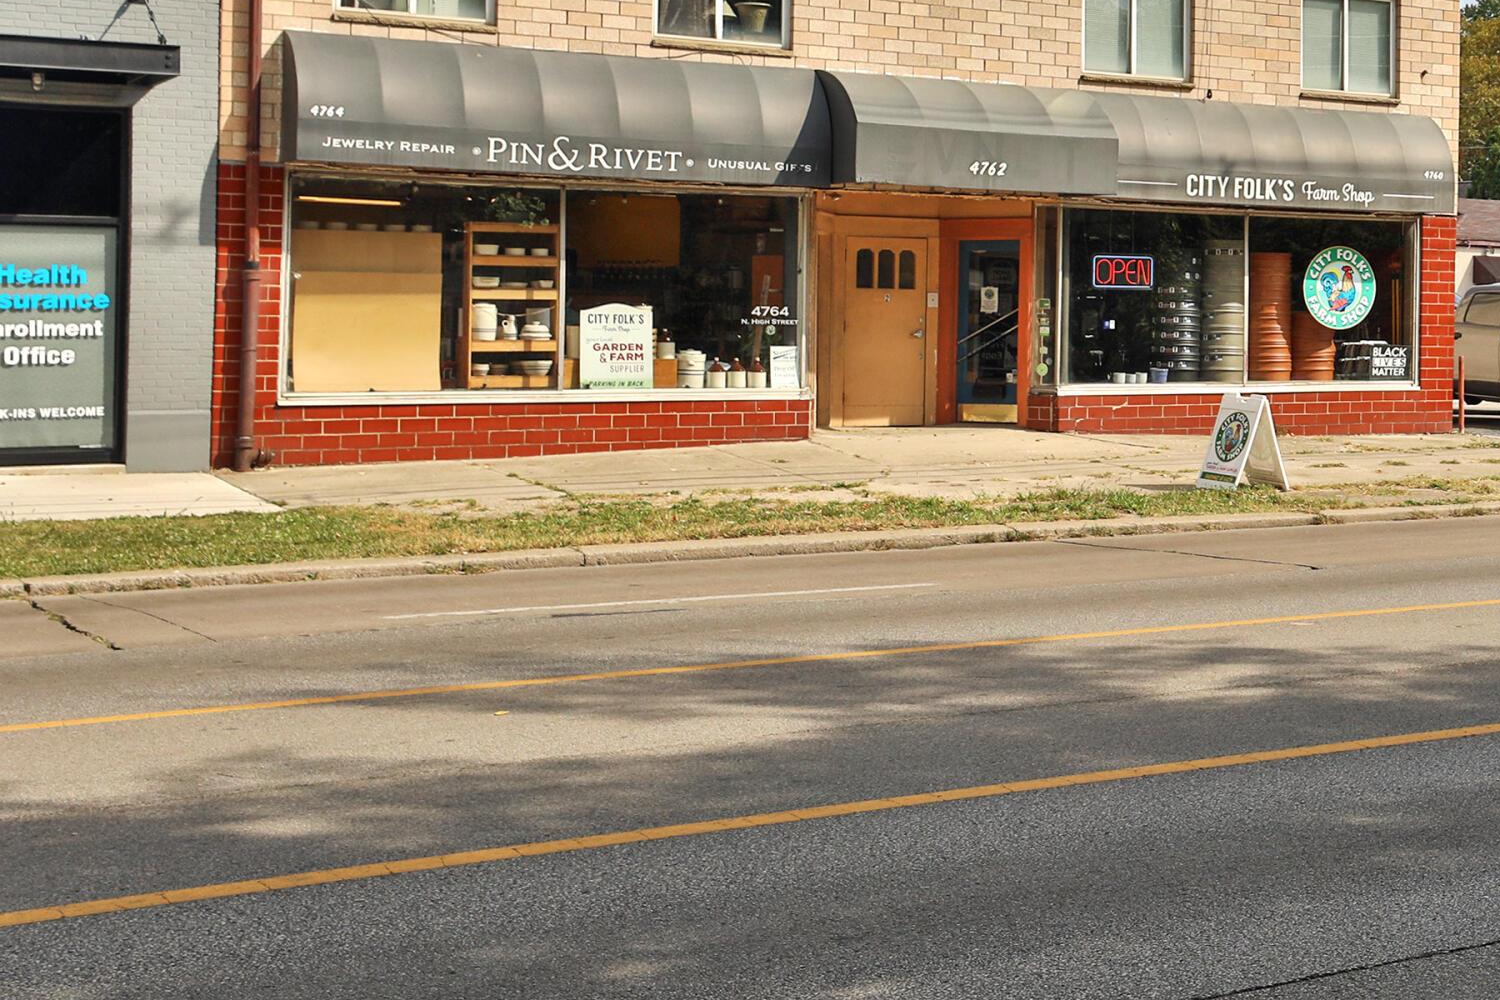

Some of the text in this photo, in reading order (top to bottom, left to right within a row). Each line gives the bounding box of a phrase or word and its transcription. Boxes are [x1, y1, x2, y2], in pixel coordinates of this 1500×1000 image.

[310, 104, 345, 117] 4764
[322, 136, 456, 154] JEWELRY REPAIR
[707, 158, 812, 172] UNUSUAL GIFS
[969, 160, 1008, 176] 4762
[1424, 170, 1444, 180] 4760
[1186, 173, 1376, 208] CITY FOLK'S Farm Shop
[1309, 248, 1372, 281] CITY FOLK'S
[0, 263, 88, 284] Health
[1095, 258, 1151, 285] OPEN
[751, 305, 789, 317] 4764
[1308, 295, 1370, 325] FARM SHOP
[587, 313, 645, 325] CITY FOLK'S
[592, 342, 644, 352] GARDEN
[1372, 346, 1408, 358] BLACK
[3, 346, 76, 366] Office
[599, 352, 644, 364] & FARM
[609, 364, 645, 373] SUPPLIER
[1372, 367, 1405, 377] MATTER
[39, 406, 105, 418] WELCOME
[1221, 414, 1237, 430] CITY
